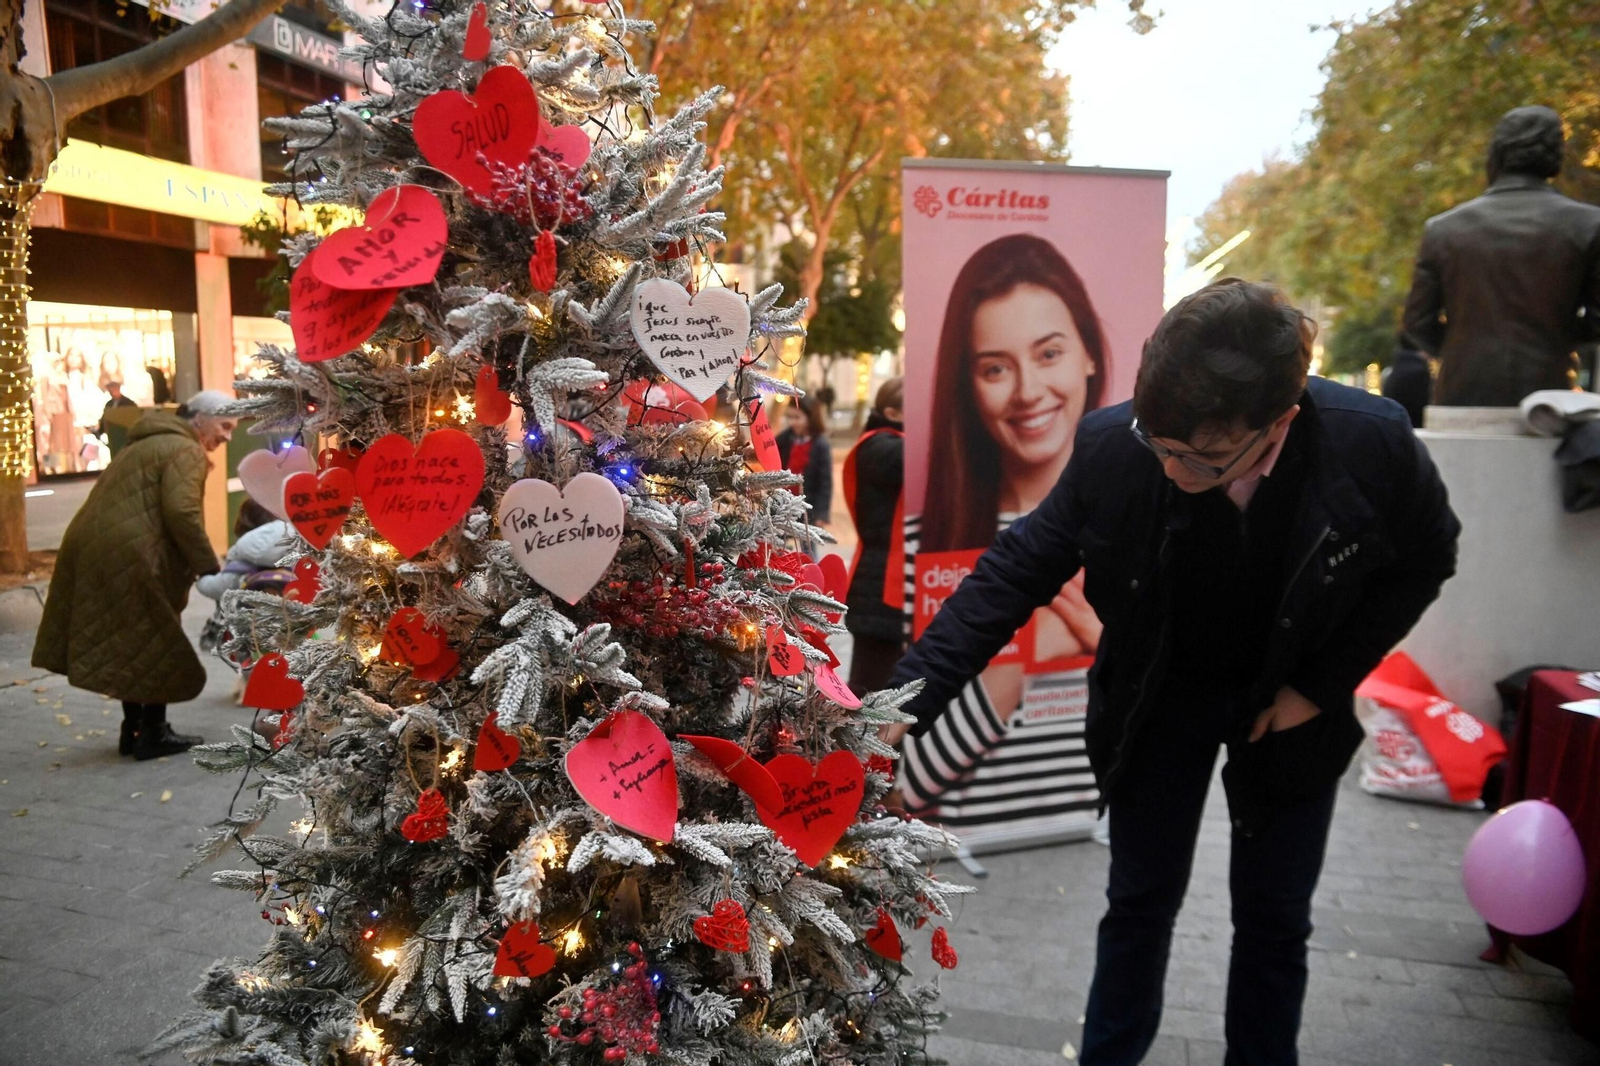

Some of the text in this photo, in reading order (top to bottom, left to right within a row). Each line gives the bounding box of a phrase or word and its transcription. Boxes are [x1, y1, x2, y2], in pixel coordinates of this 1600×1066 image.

[450, 103, 510, 158] SALUD
[947, 186, 1050, 210] Cáritas
[375, 455, 460, 472] Dios nace
[372, 474, 409, 489] para
[523, 514, 622, 555] NECESITADOS
